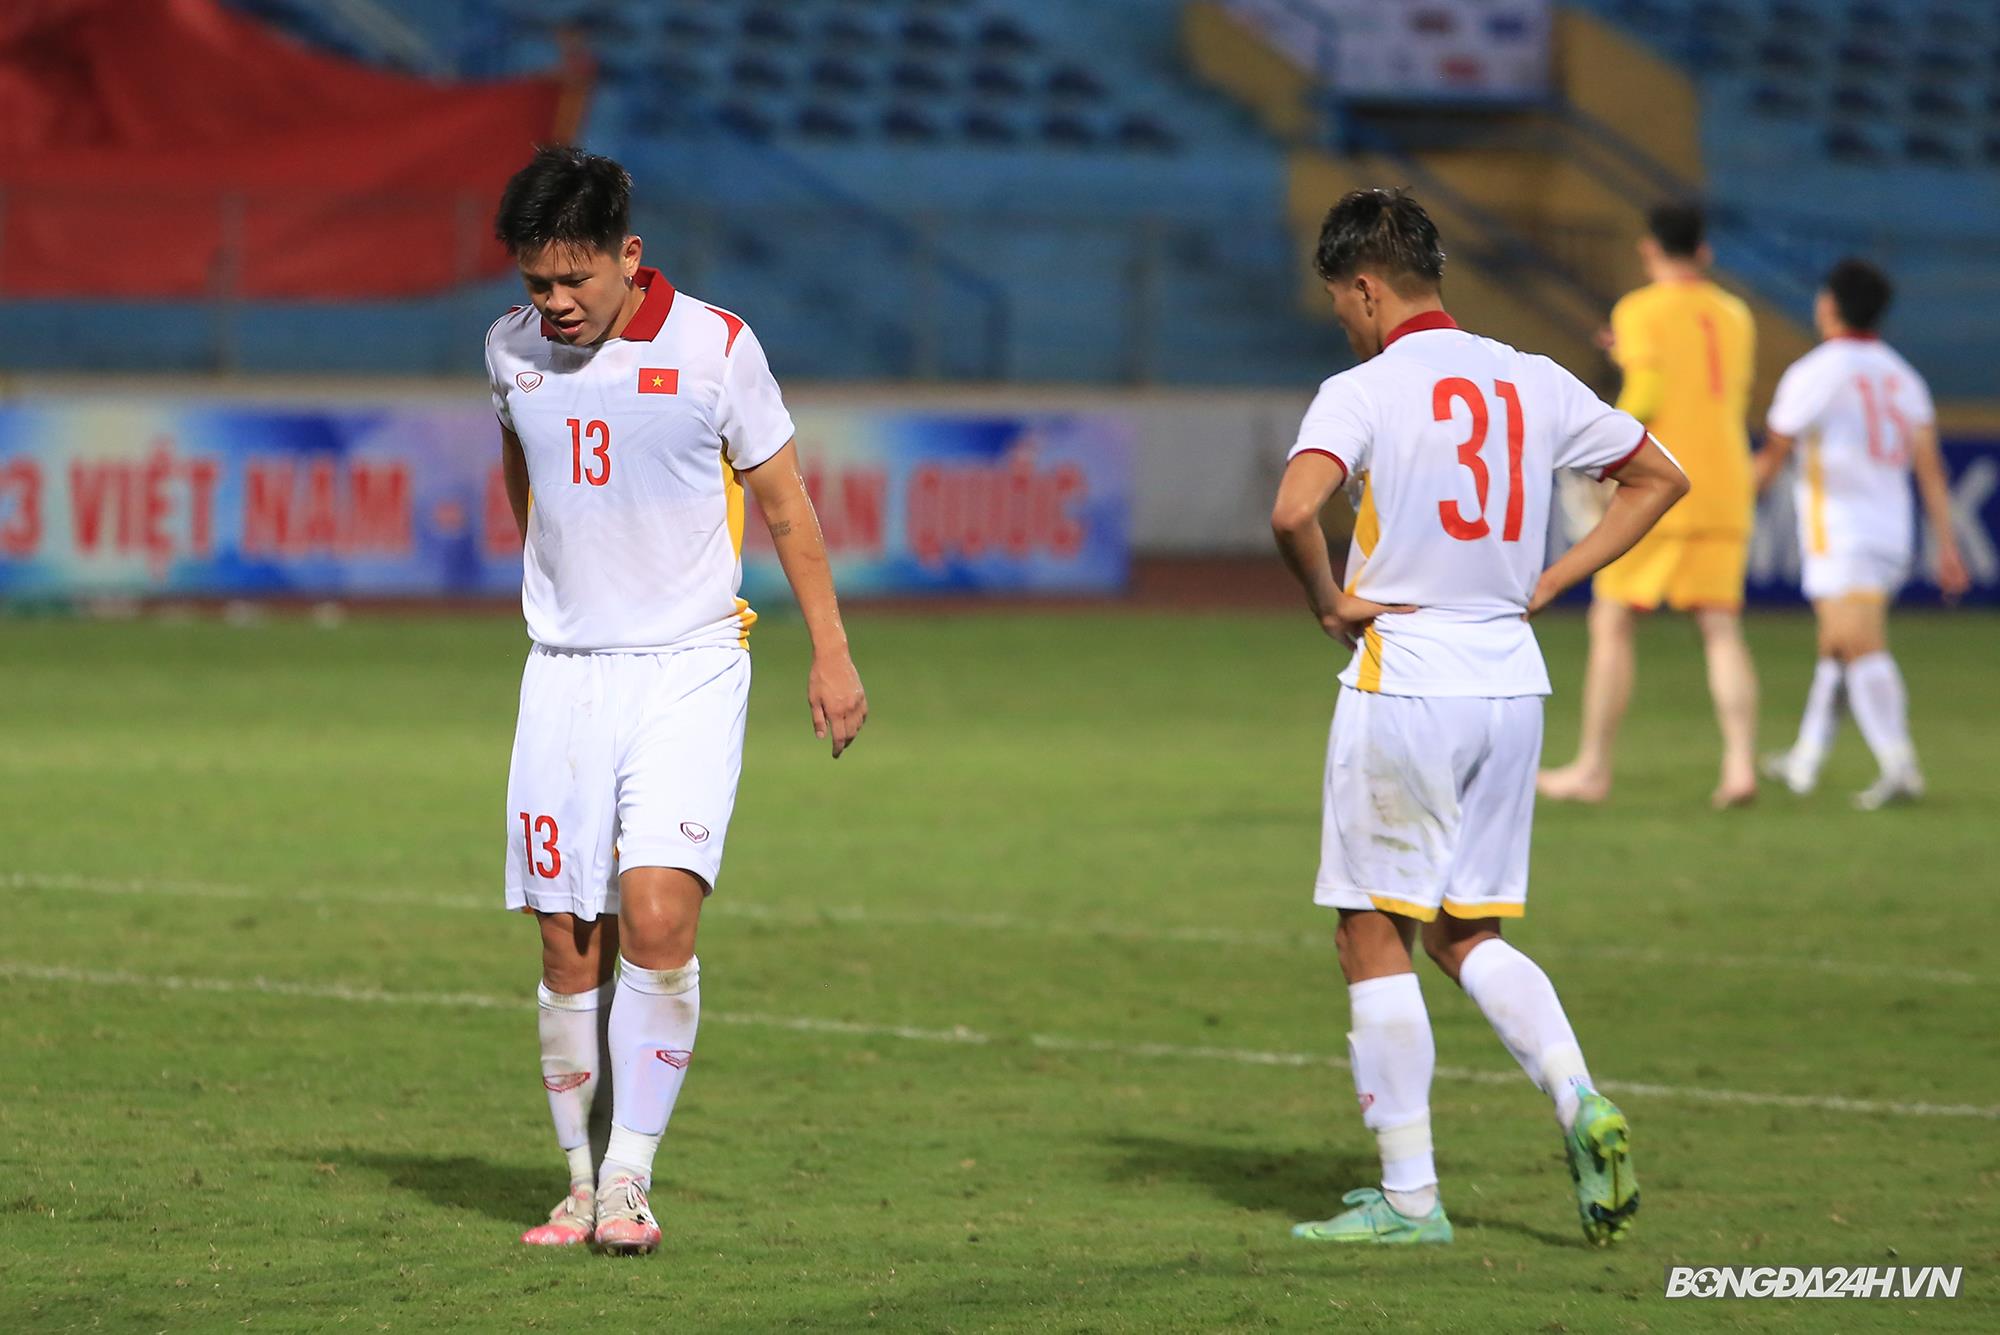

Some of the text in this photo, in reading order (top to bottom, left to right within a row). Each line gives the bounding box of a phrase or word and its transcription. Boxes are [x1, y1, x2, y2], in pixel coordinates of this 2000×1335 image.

[566, 418, 611, 486] 13
[1432, 377, 1524, 541] 31
[70, 436, 220, 580] VIỆT
[244, 459, 413, 557] NAM
[520, 812, 562, 879] 13
